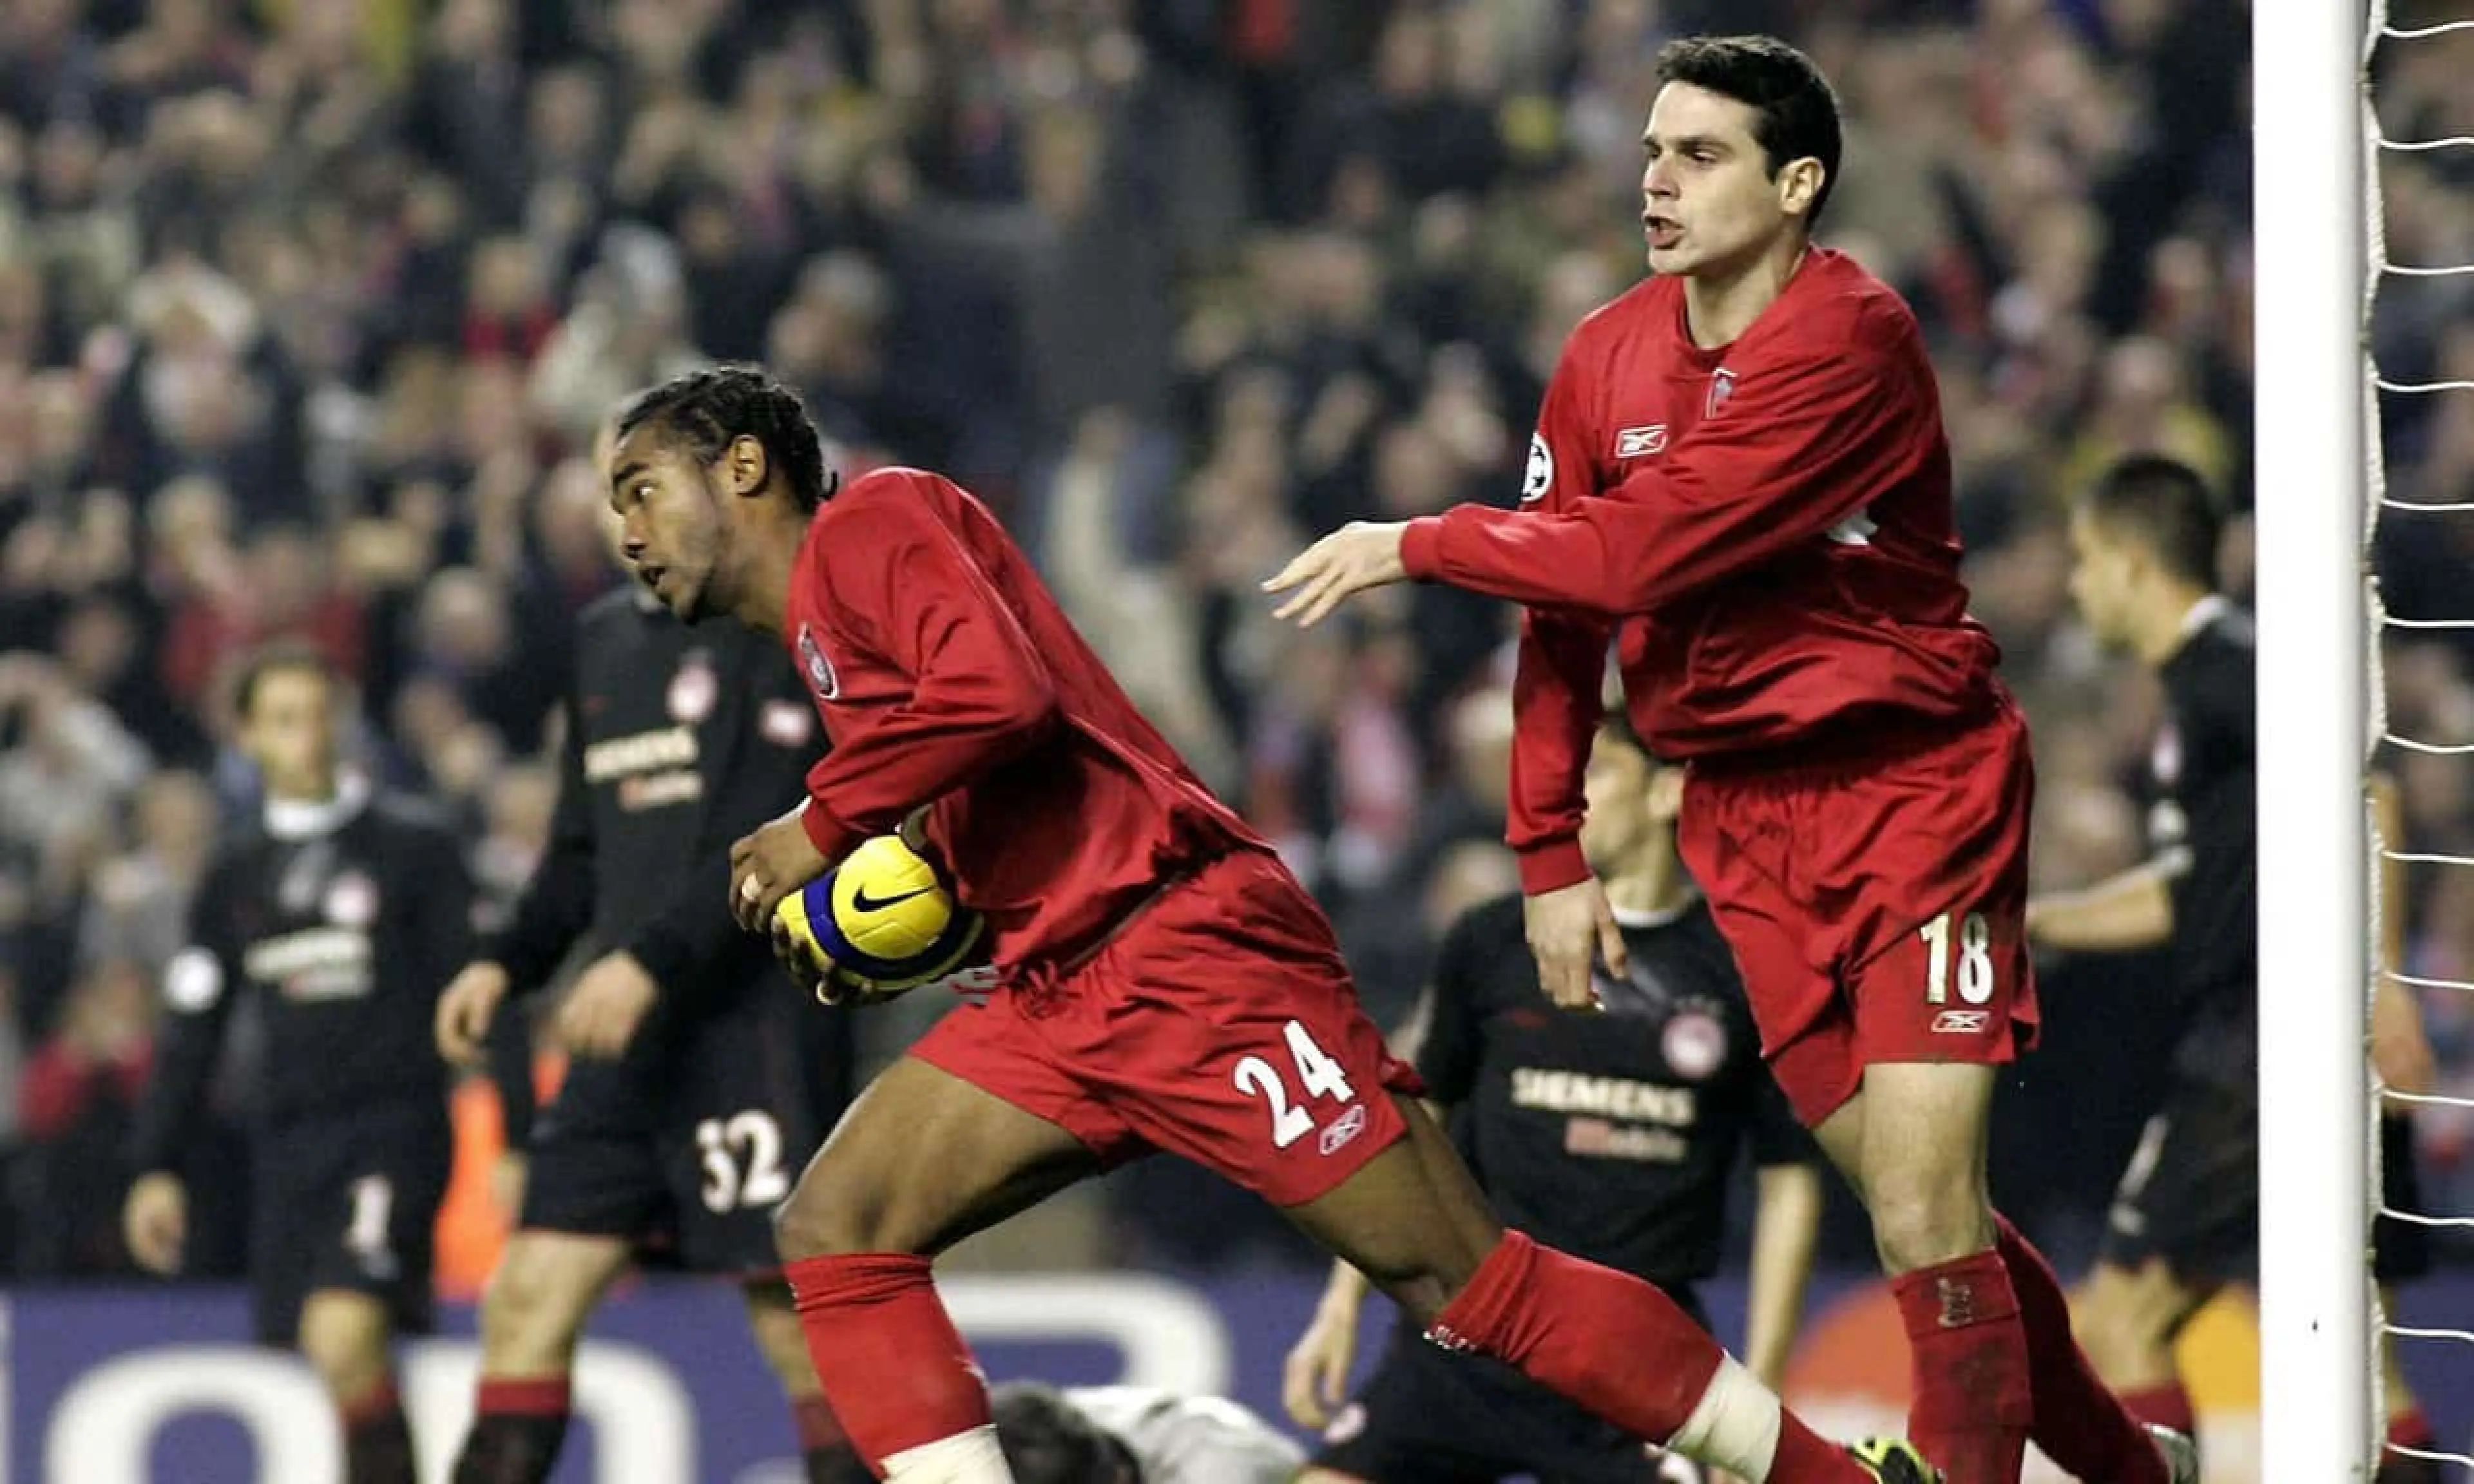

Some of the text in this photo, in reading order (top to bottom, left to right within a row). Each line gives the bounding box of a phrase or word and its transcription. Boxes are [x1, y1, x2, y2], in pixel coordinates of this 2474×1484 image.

[1919, 911, 1994, 1004] 18
[1234, 1020, 1356, 1148] 24
[1511, 1067, 1696, 1126] SIEMENS
[695, 1109, 789, 1213] 32
